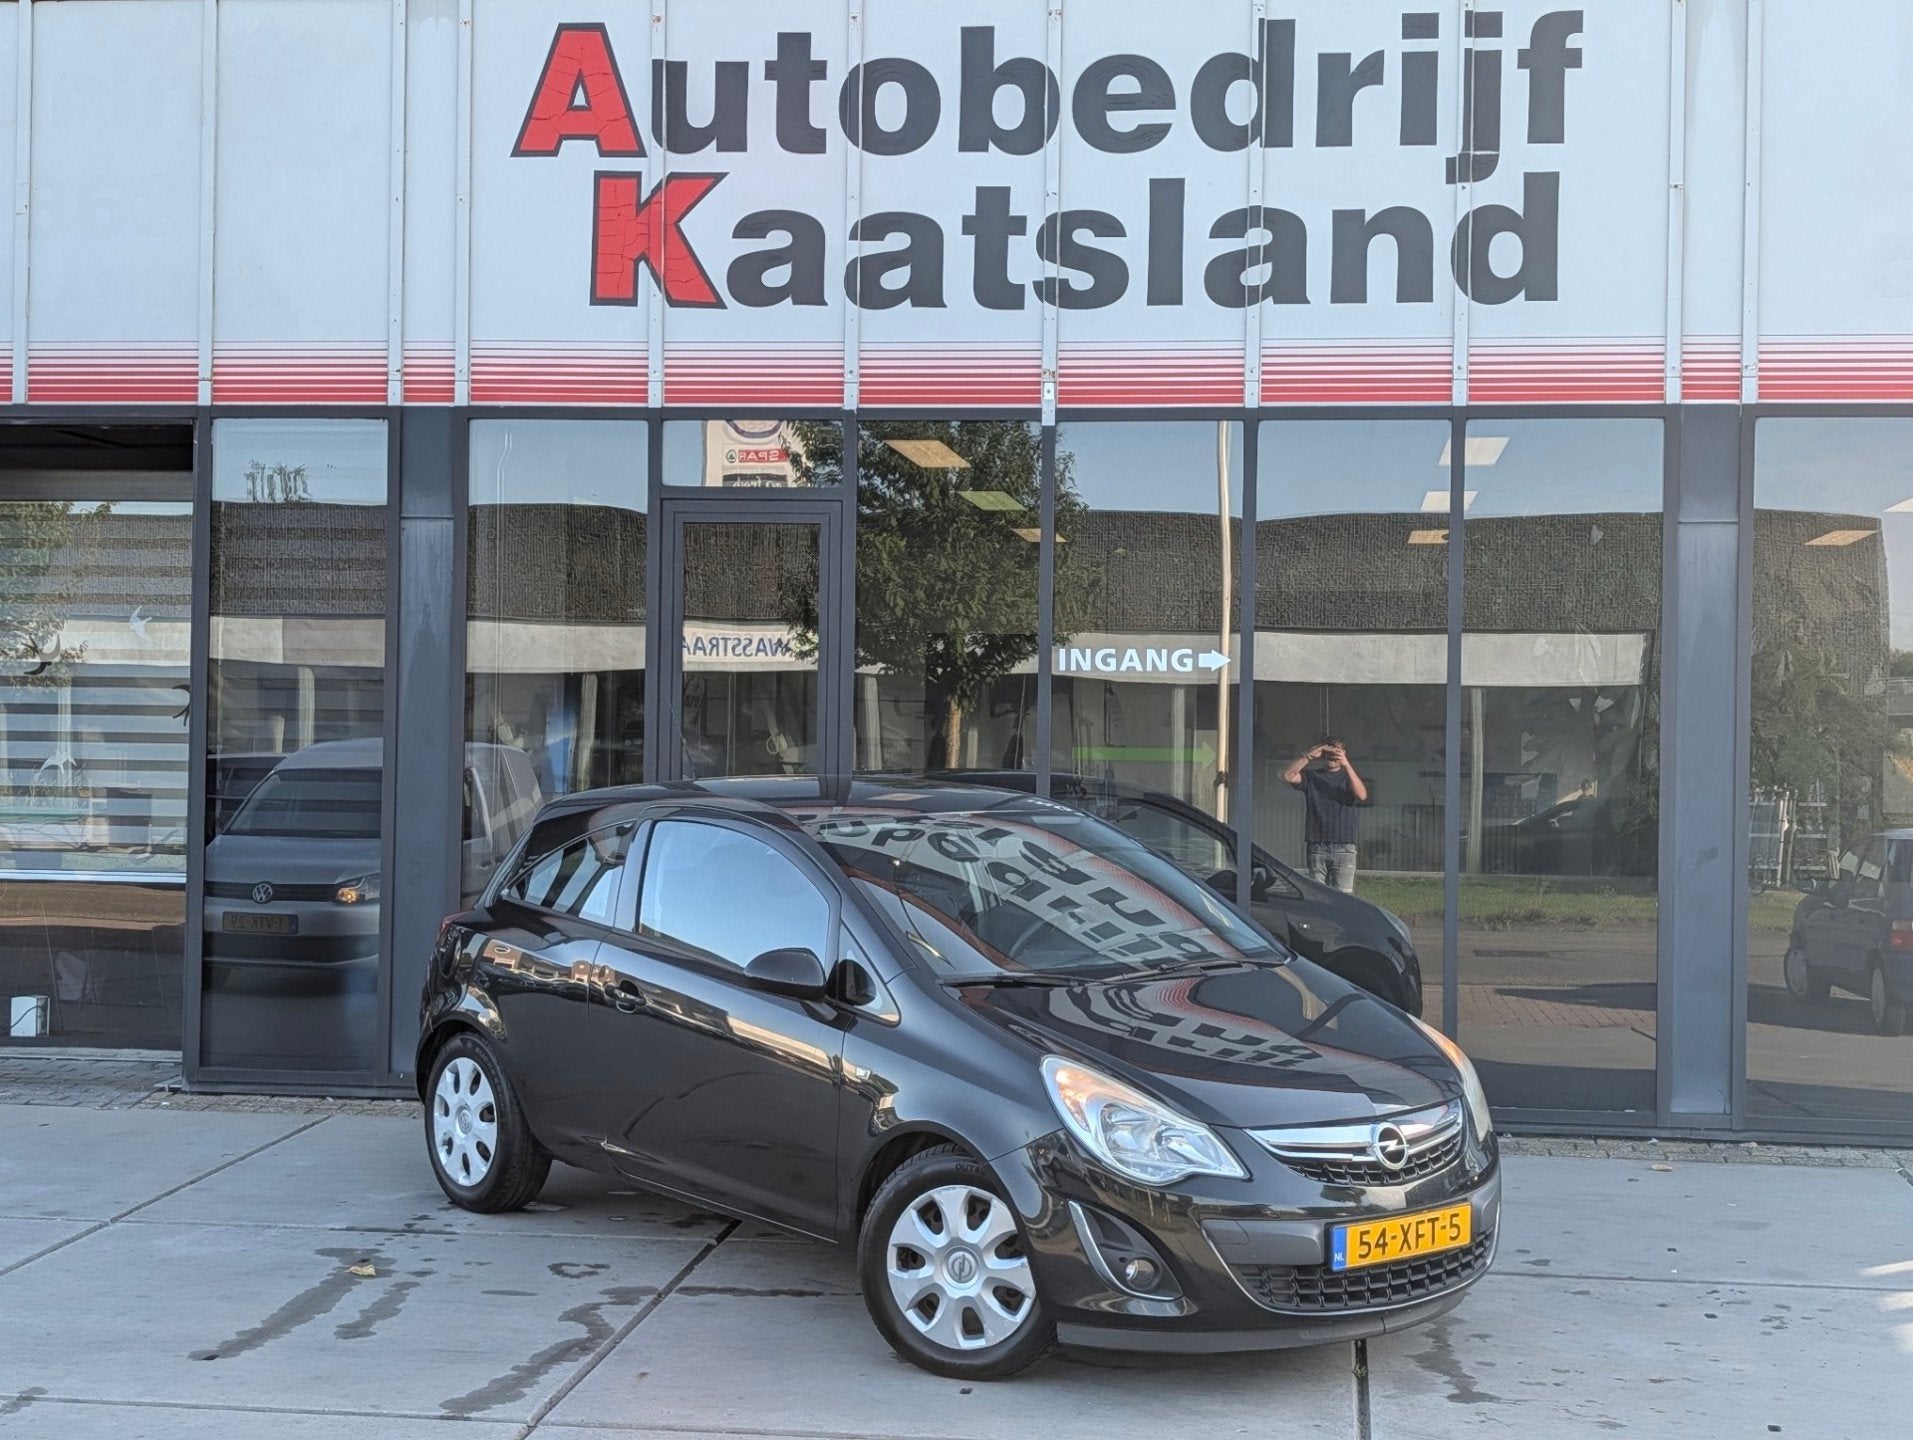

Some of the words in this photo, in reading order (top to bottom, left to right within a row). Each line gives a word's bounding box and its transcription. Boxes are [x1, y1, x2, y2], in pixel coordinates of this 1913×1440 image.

[510, 10, 1583, 184] Autobedrijf
[590, 170, 1560, 310] Kaatsland
[1058, 647, 1194, 673] INGANG
[1334, 1251, 1345, 1263] NL
[1358, 1213, 1461, 1260] 54-XFT-5
